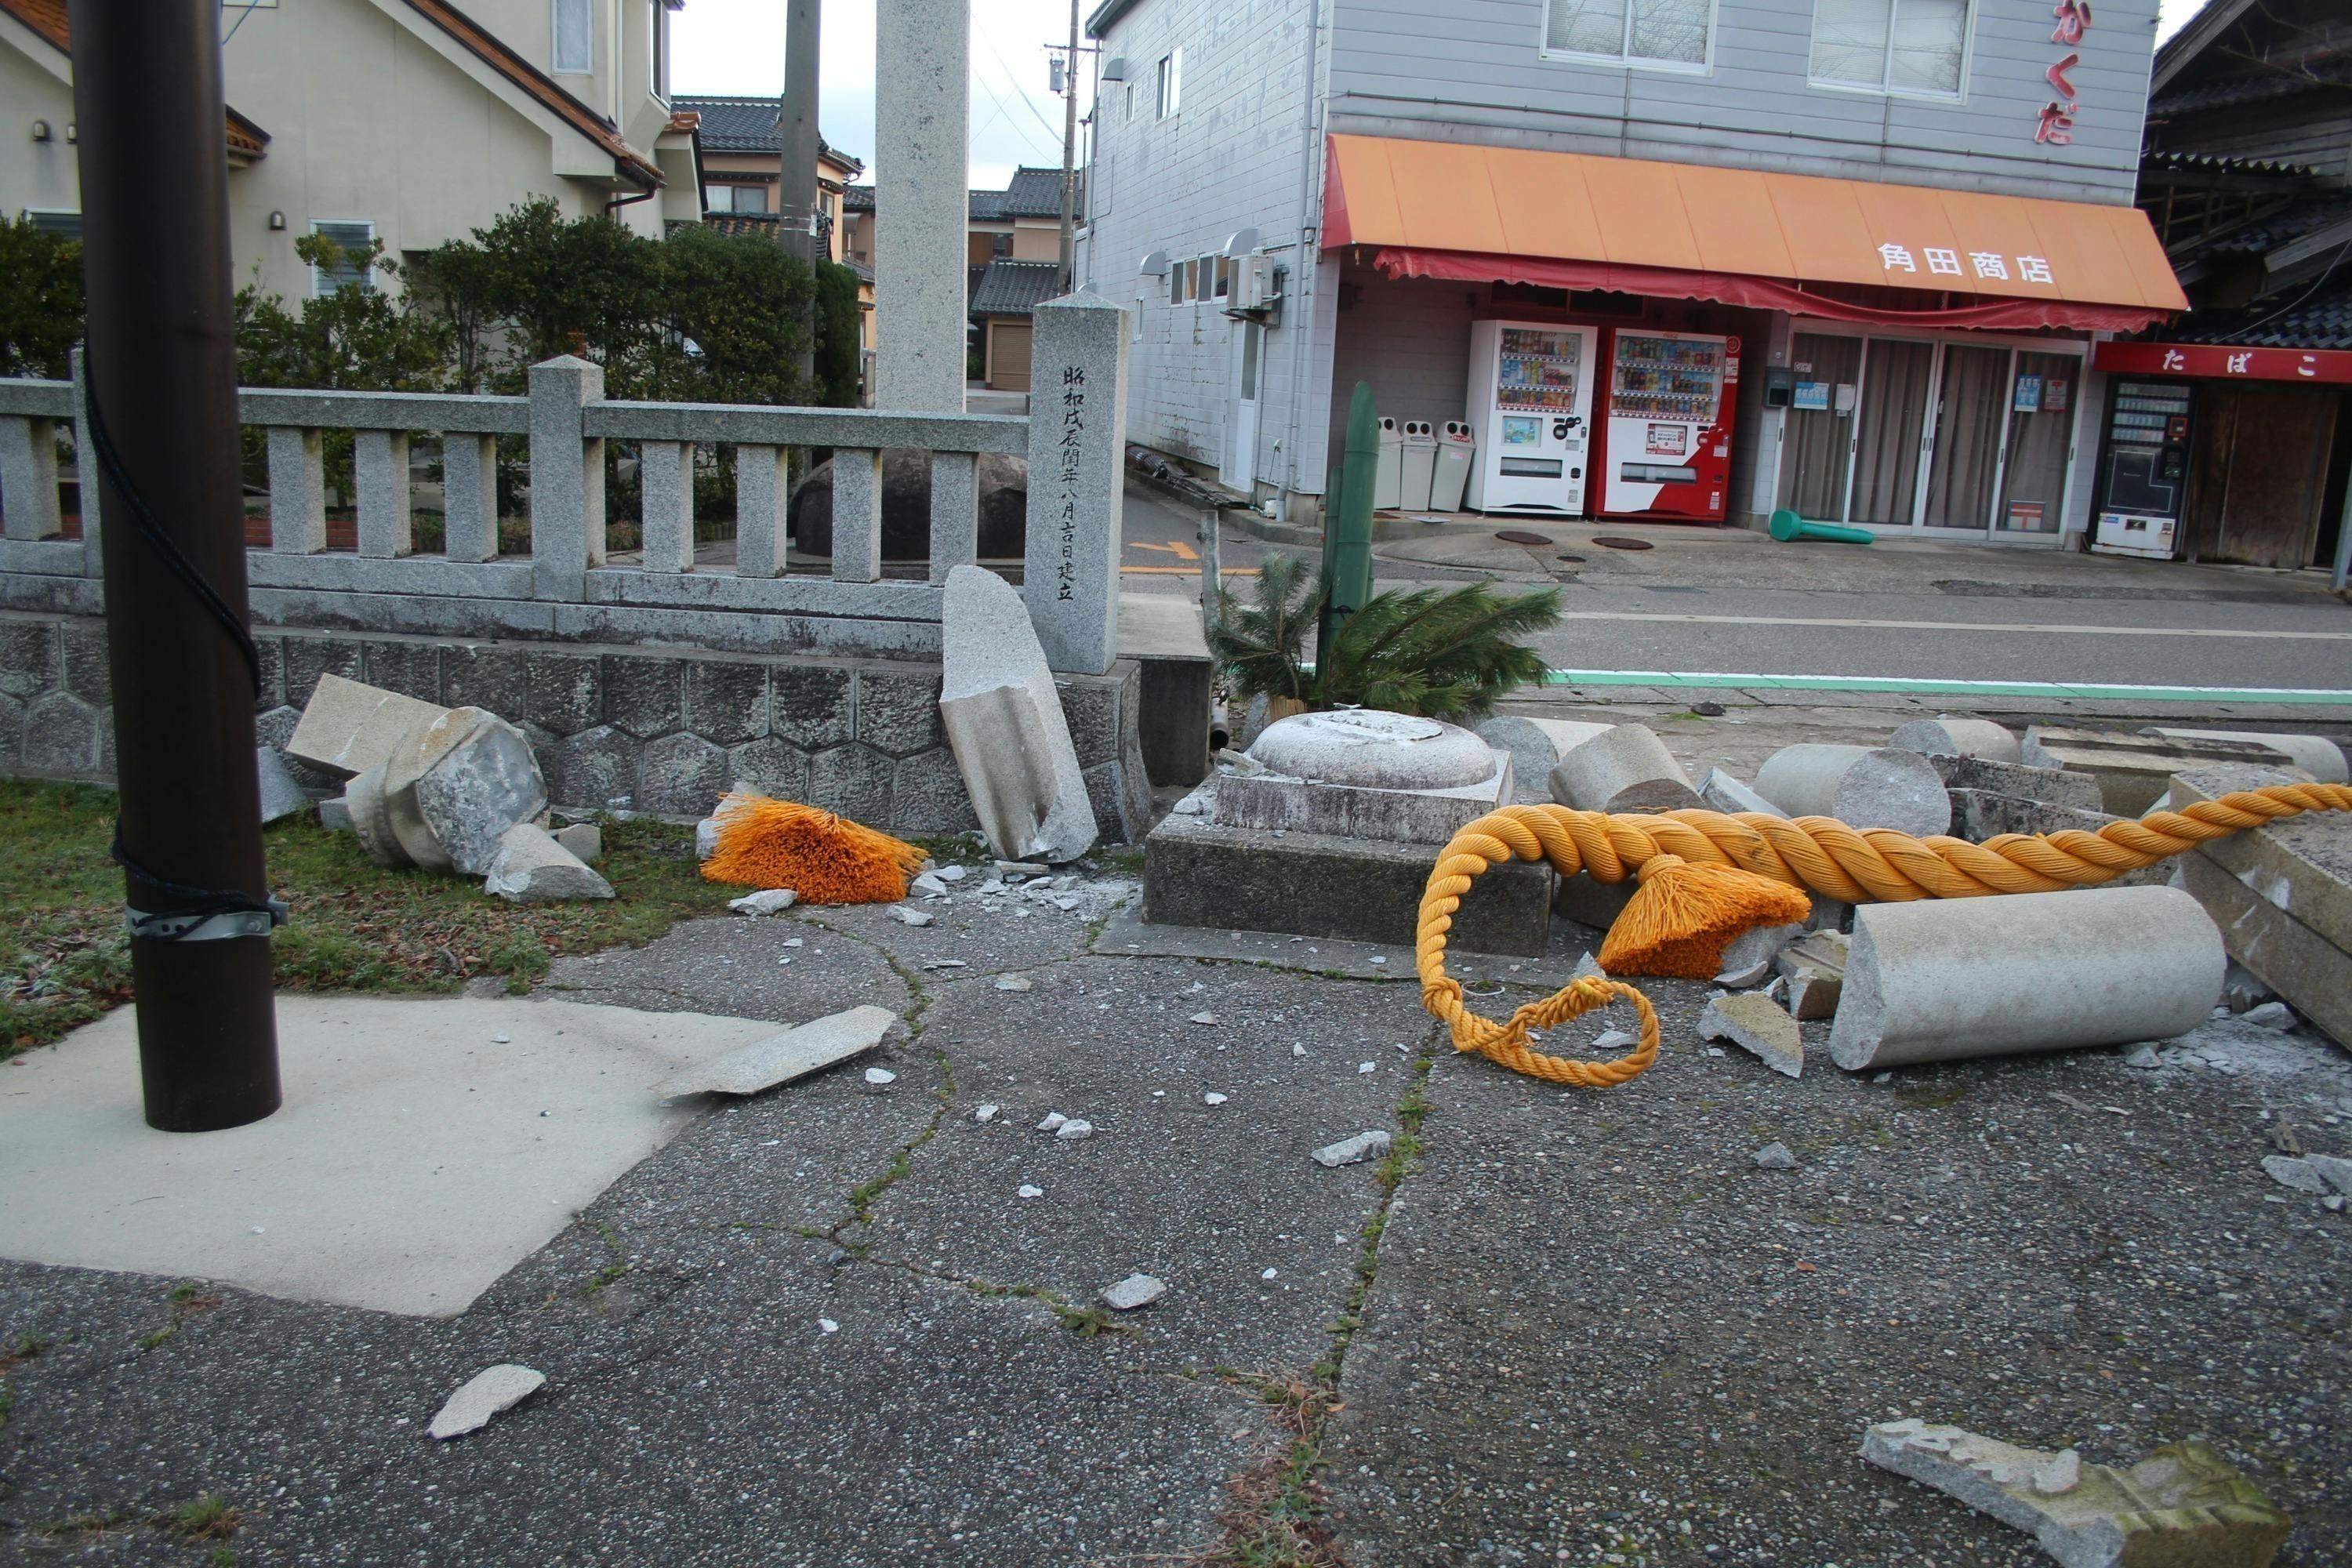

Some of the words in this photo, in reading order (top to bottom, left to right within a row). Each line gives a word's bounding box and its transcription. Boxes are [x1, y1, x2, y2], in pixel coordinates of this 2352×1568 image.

[2034, 0, 2092, 144] かくだ
[1877, 242, 2053, 284] 角田商店
[2162, 349, 2314, 376] たばこ
